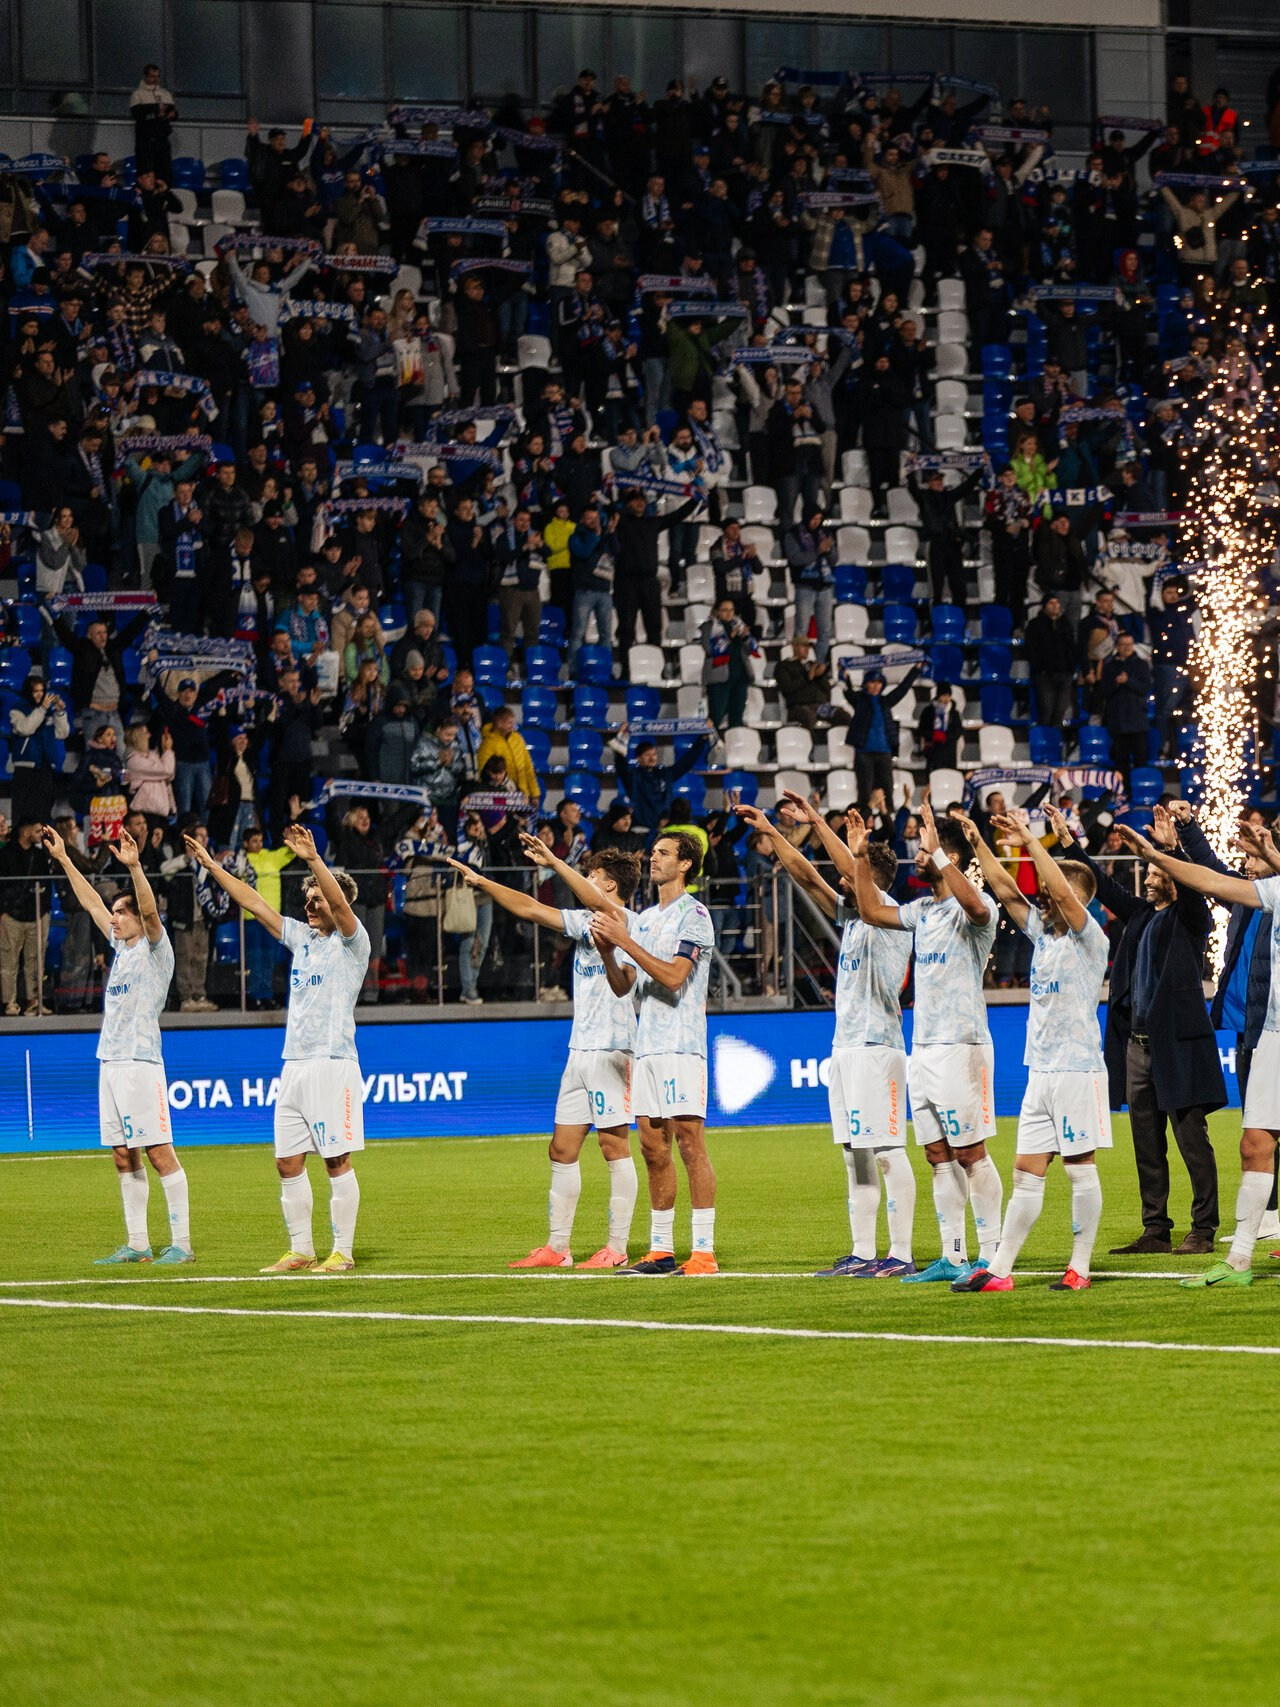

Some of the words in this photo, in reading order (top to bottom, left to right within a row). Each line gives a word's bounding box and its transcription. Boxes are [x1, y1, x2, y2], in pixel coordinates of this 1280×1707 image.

[346, 784, 409, 798] ФАКЕЛ
[168, 1079, 233, 1110] ОТА
[361, 1071, 468, 1104] УЛЬТАТ
[663, 1078, 677, 1105] 21
[313, 1121, 327, 1147] 17
[1063, 1115, 1075, 1143] 4
